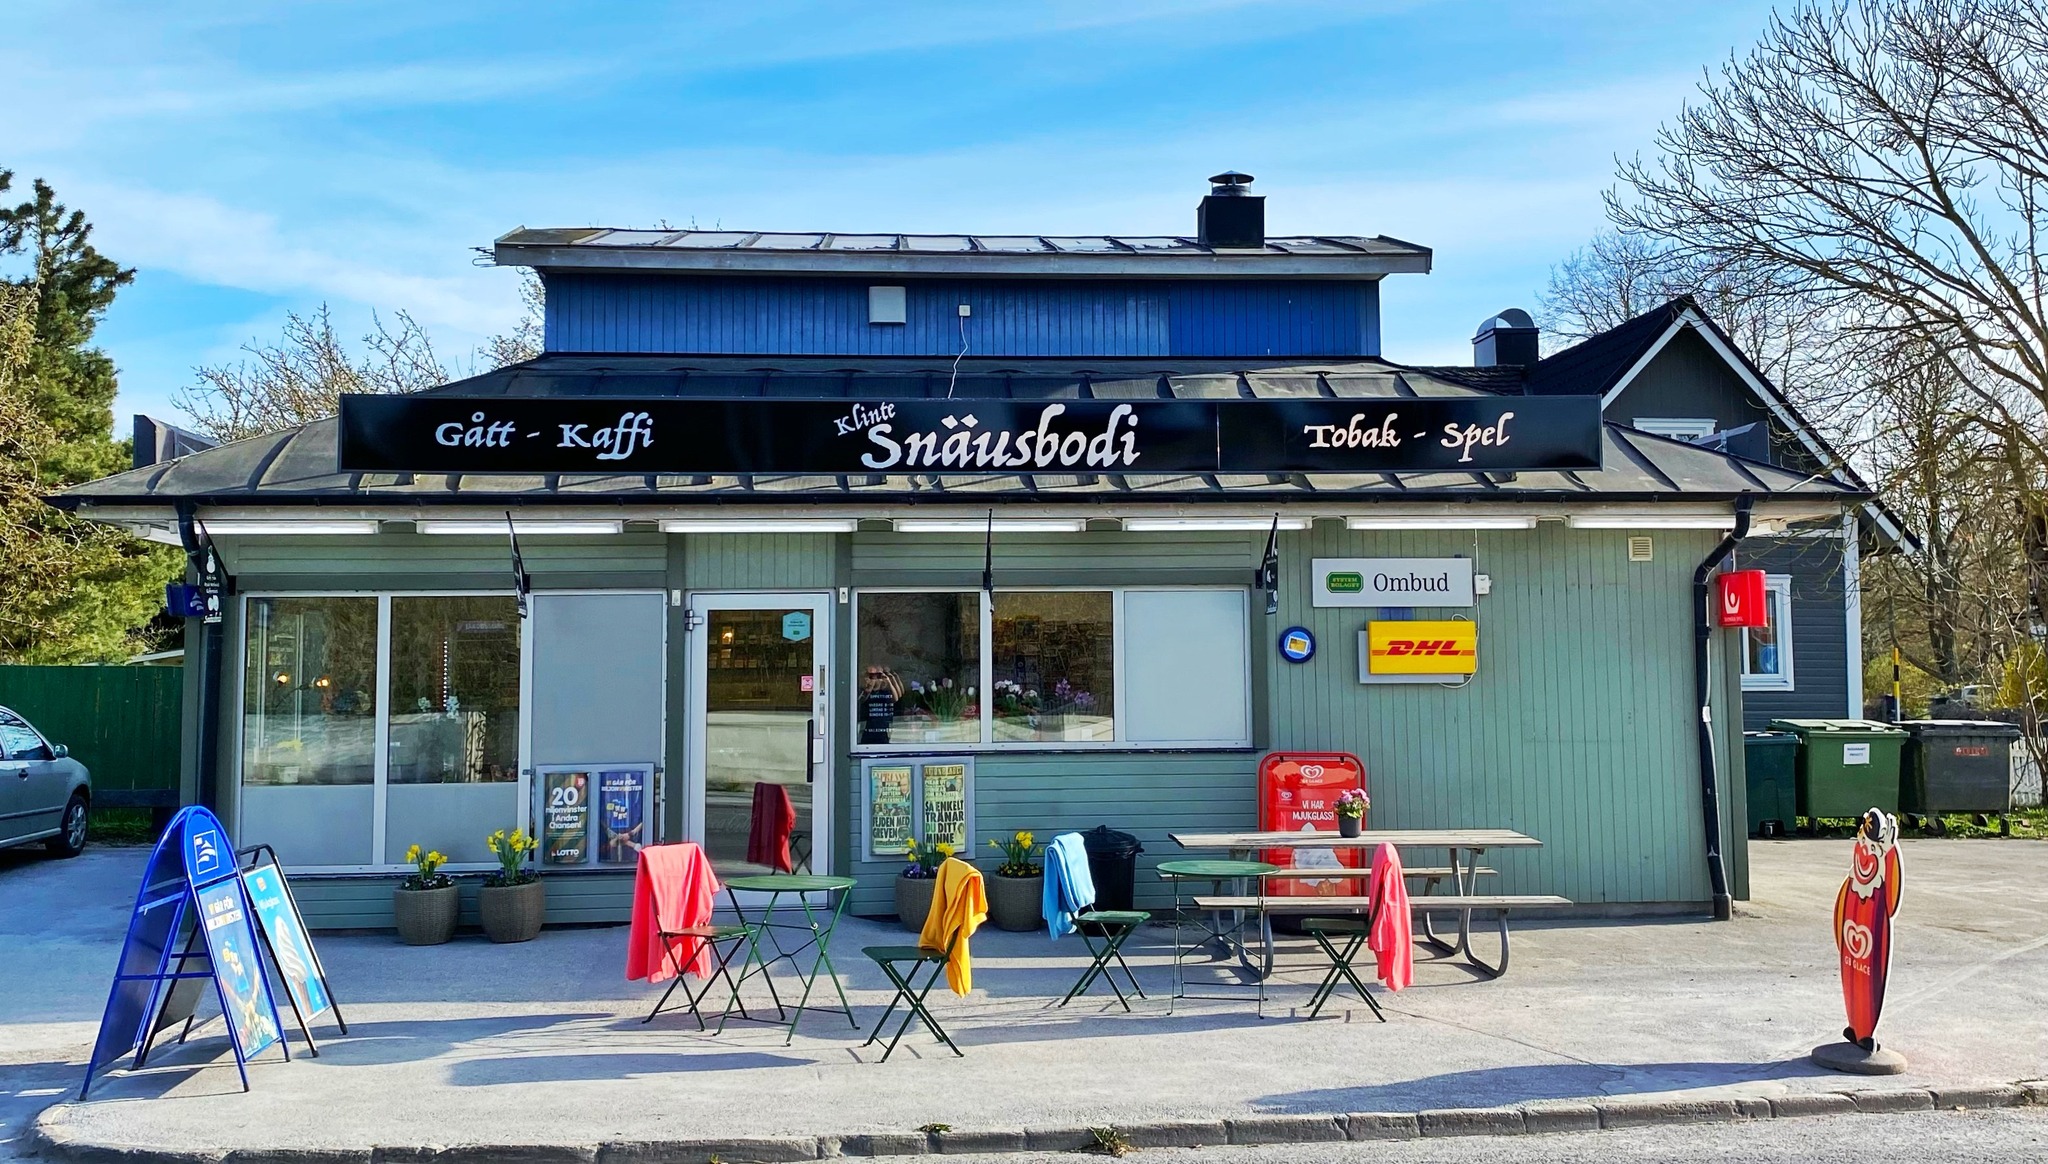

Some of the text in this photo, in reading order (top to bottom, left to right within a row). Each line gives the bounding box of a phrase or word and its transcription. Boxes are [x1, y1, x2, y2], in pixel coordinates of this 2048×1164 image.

[833, 401, 896, 437] Klinte
[435, 411, 515, 447] Gått
[557, 411, 654, 460] Kaffi
[861, 403, 1141, 468] Snäusbodi
[1304, 413, 1401, 448] Tobak
[1440, 412, 1514, 463] Spel
[1373, 572, 1450, 592] Ombud
[1387, 640, 1461, 656] DHL
[552, 786, 578, 806] 20
[936, 800, 963, 812] ENKELT
[1302, 800, 1324, 809] VI HAR
[556, 813, 578, 821] Andra
[872, 816, 895, 828] FEJDEN
[1292, 811, 1334, 820] MJUKGLASS!
[549, 821, 581, 829] Chansen!
[925, 822, 957, 833] DU DITT
[926, 833, 955, 844] MINNE
[1853, 959, 1871, 976] GLACE
